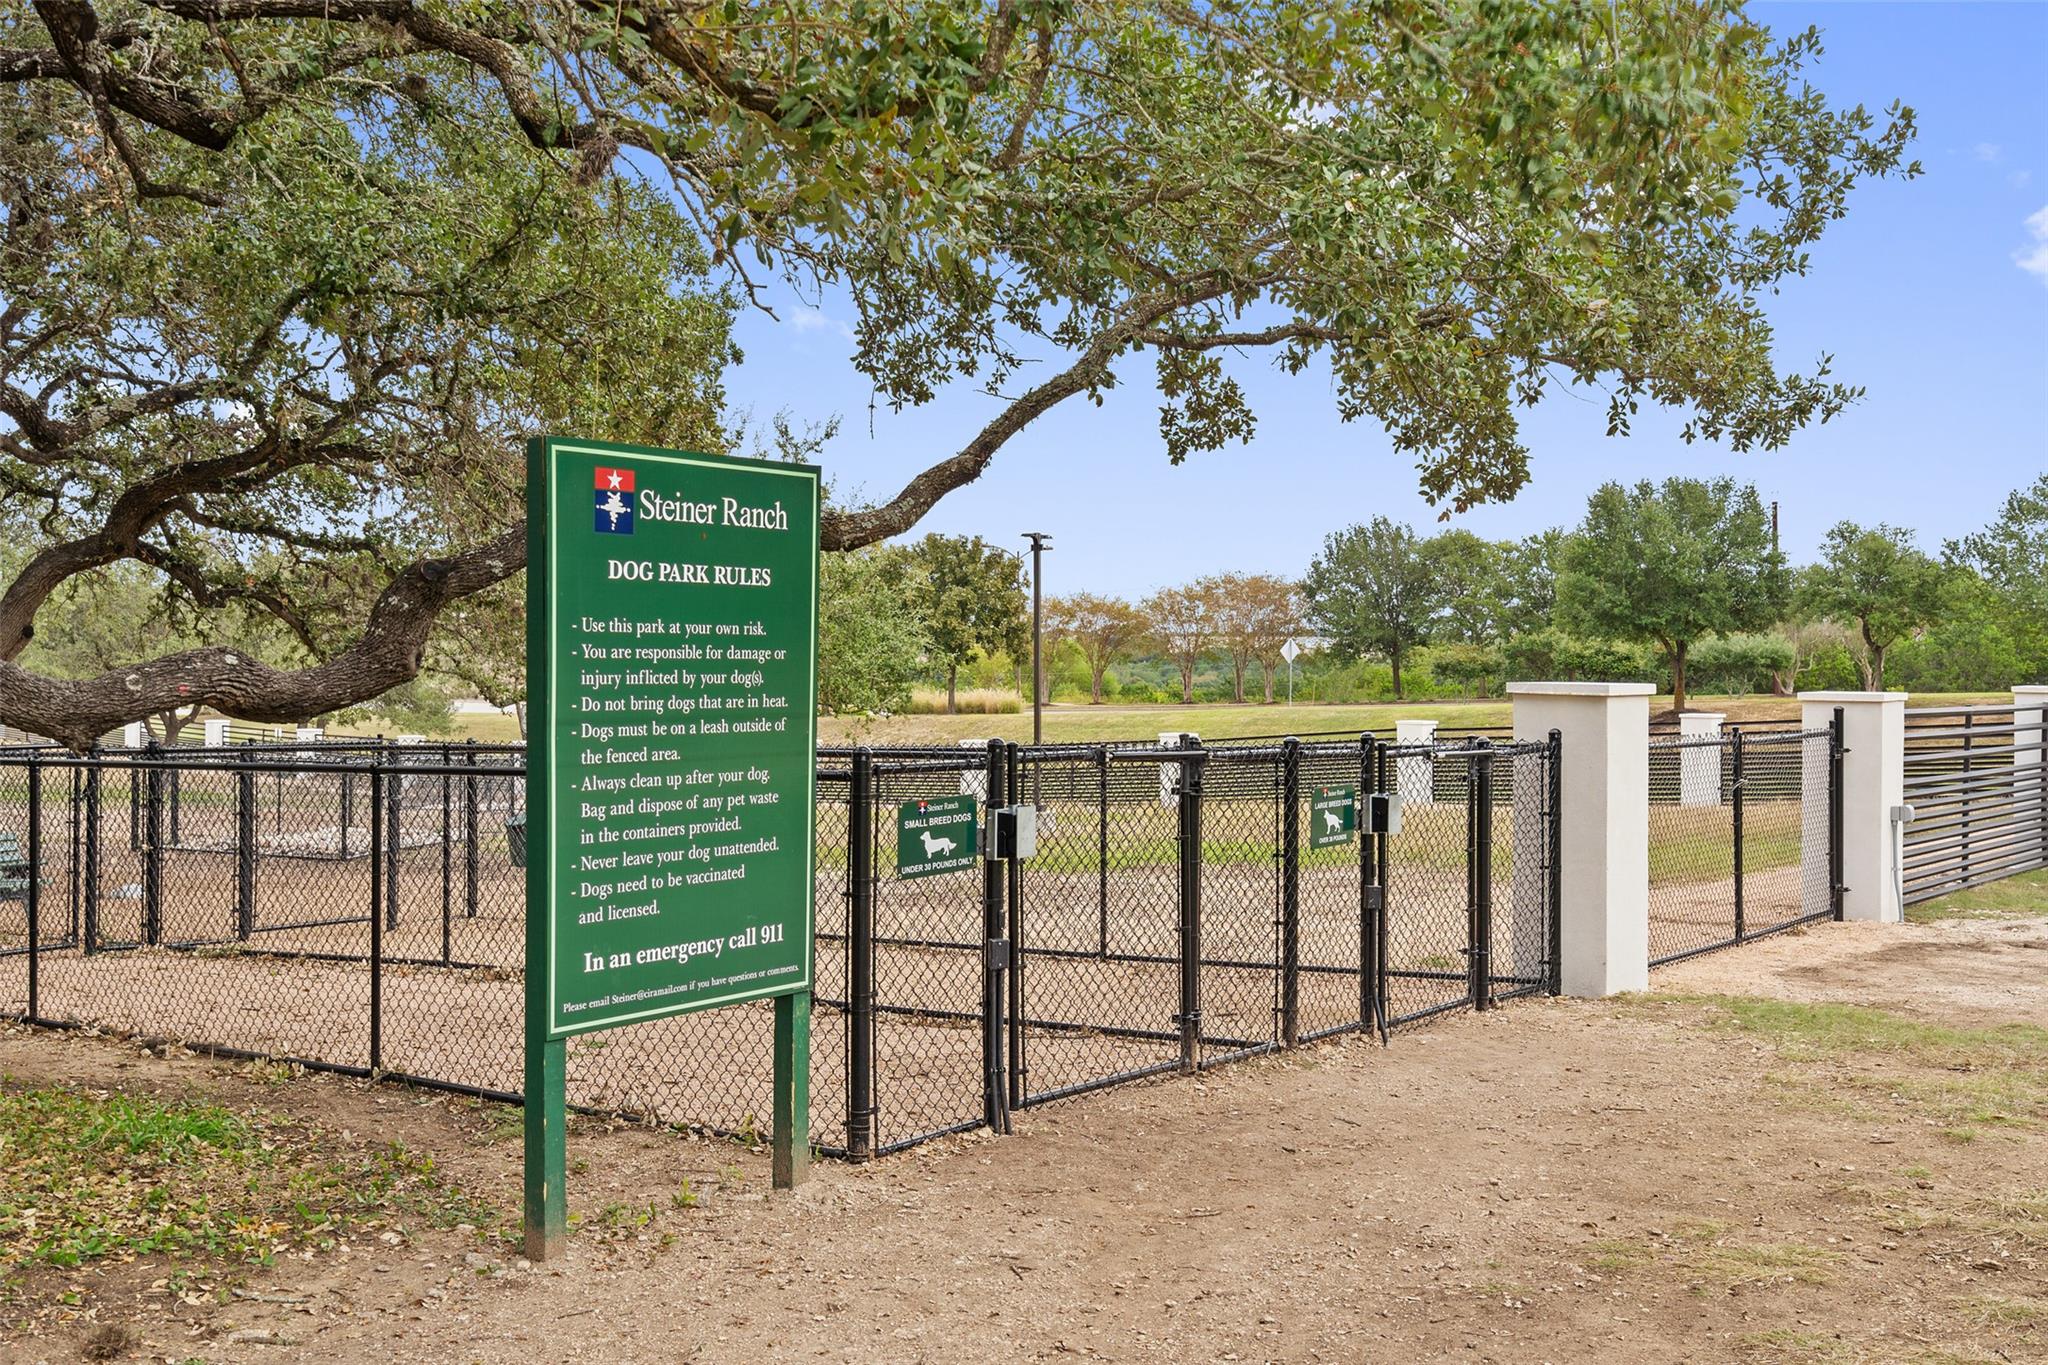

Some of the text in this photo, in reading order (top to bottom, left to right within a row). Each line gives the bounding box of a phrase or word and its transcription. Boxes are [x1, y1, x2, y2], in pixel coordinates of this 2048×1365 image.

[640, 489, 788, 530] Steiner Ranch
[608, 559, 771, 587] DOG PARK RULES
[581, 617, 606, 632] Use
[609, 617, 633, 633] this
[636, 618, 665, 638] park
[669, 622, 681, 634] at
[685, 624, 713, 639] your
[715, 624, 740, 635] own
[743, 621, 767, 636] risk.
[581, 643, 607, 659] You
[610, 648, 632, 659] are
[635, 644, 703, 664] responsible
[706, 645, 723, 659] for
[726, 645, 772, 664] damage
[774, 650, 787, 660] or
[581, 669, 764, 690] injury inflicted by your dog(s).
[581, 696, 601, 712] Do
[605, 699, 626, 711] not
[630, 695, 664, 715] bring
[667, 695, 695, 714] dogs
[699, 694, 722, 709] that
[725, 698, 744, 708] are
[747, 694, 759, 708] in
[762, 693, 788, 708] heat.
[581, 723, 614, 742] Dogs
[618, 724, 648, 737] must
[652, 720, 667, 736] be
[670, 724, 686, 735] on
[689, 724, 697, 734] a
[700, 719, 729, 734] leash
[732, 717, 772, 733] outside
[774, 717, 787, 731] of
[581, 746, 681, 765] the fenced area.
[581, 775, 626, 794] Always
[630, 773, 662, 788] clean
[666, 775, 682, 790] up
[685, 769, 714, 784] after
[718, 771, 744, 787] your
[747, 766, 770, 784] dog.
[581, 792, 779, 821] Bag and dispose of any pet waste
[927, 801, 959, 812] Steiner Ranch
[1314, 798, 1352, 809] LARGE BREED DOGS
[581, 816, 742, 845] in the containers provided.
[904, 813, 972, 829] SMALL BREED DOGS
[581, 855, 619, 871] Never
[623, 851, 654, 867] leave
[657, 850, 685, 868] your
[688, 844, 711, 862] dog
[714, 836, 779, 857] unattended.
[901, 856, 973, 874] UNDER 30 POUNDS ONLY
[580, 882, 613, 900] Dogs
[617, 875, 647, 893] need
[651, 875, 664, 889] to
[668, 872, 683, 887] be
[686, 864, 745, 885] vaccinated
[578, 899, 660, 925] and licensed.
[584, 923, 784, 973] In an emergency call 911
[563, 1002, 587, 1013] Please
[588, 995, 610, 1008] email
[689, 980, 696, 990] if
[697, 980, 710, 991] you
[711, 977, 727, 986] have
[728, 971, 757, 985] questions
